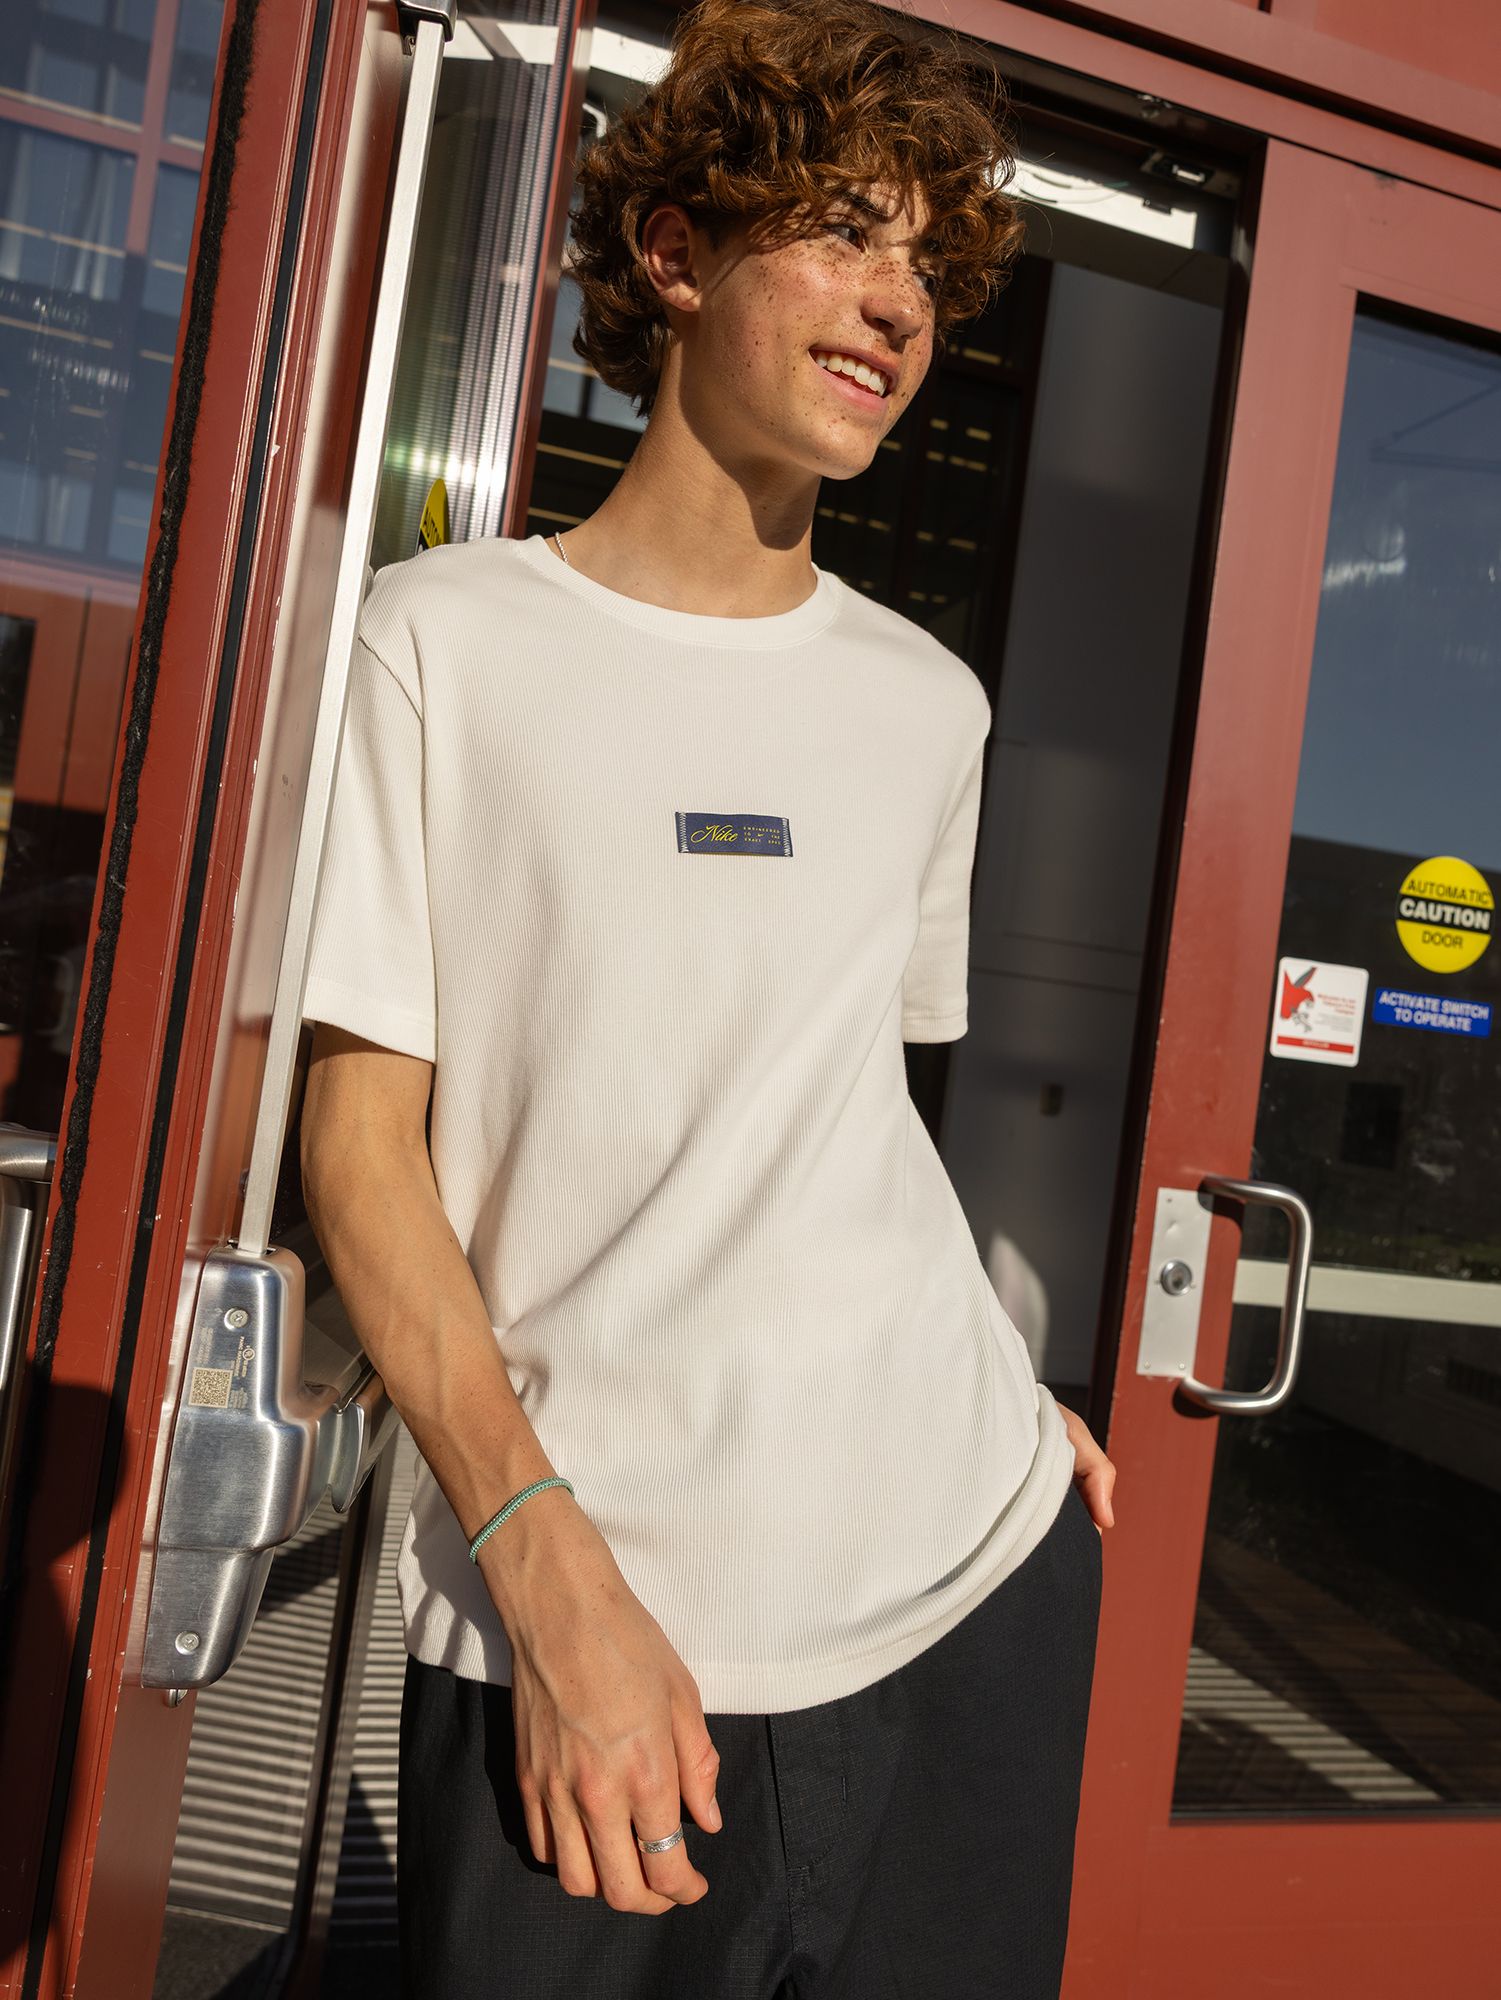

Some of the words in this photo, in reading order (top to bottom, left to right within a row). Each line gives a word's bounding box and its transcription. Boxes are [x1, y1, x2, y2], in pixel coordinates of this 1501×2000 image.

[690, 824, 739, 843] Nike
[1407, 880, 1491, 904] AUTOMATIC
[1400, 898, 1491, 930] CAUTION
[1422, 931, 1463, 948] DOOR
[1379, 991, 1440, 1012] ACTIVATE
[1441, 1000, 1489, 1019] SWITCH
[1394, 1007, 1412, 1023] TO
[1413, 1010, 1472, 1032] OPERATE
